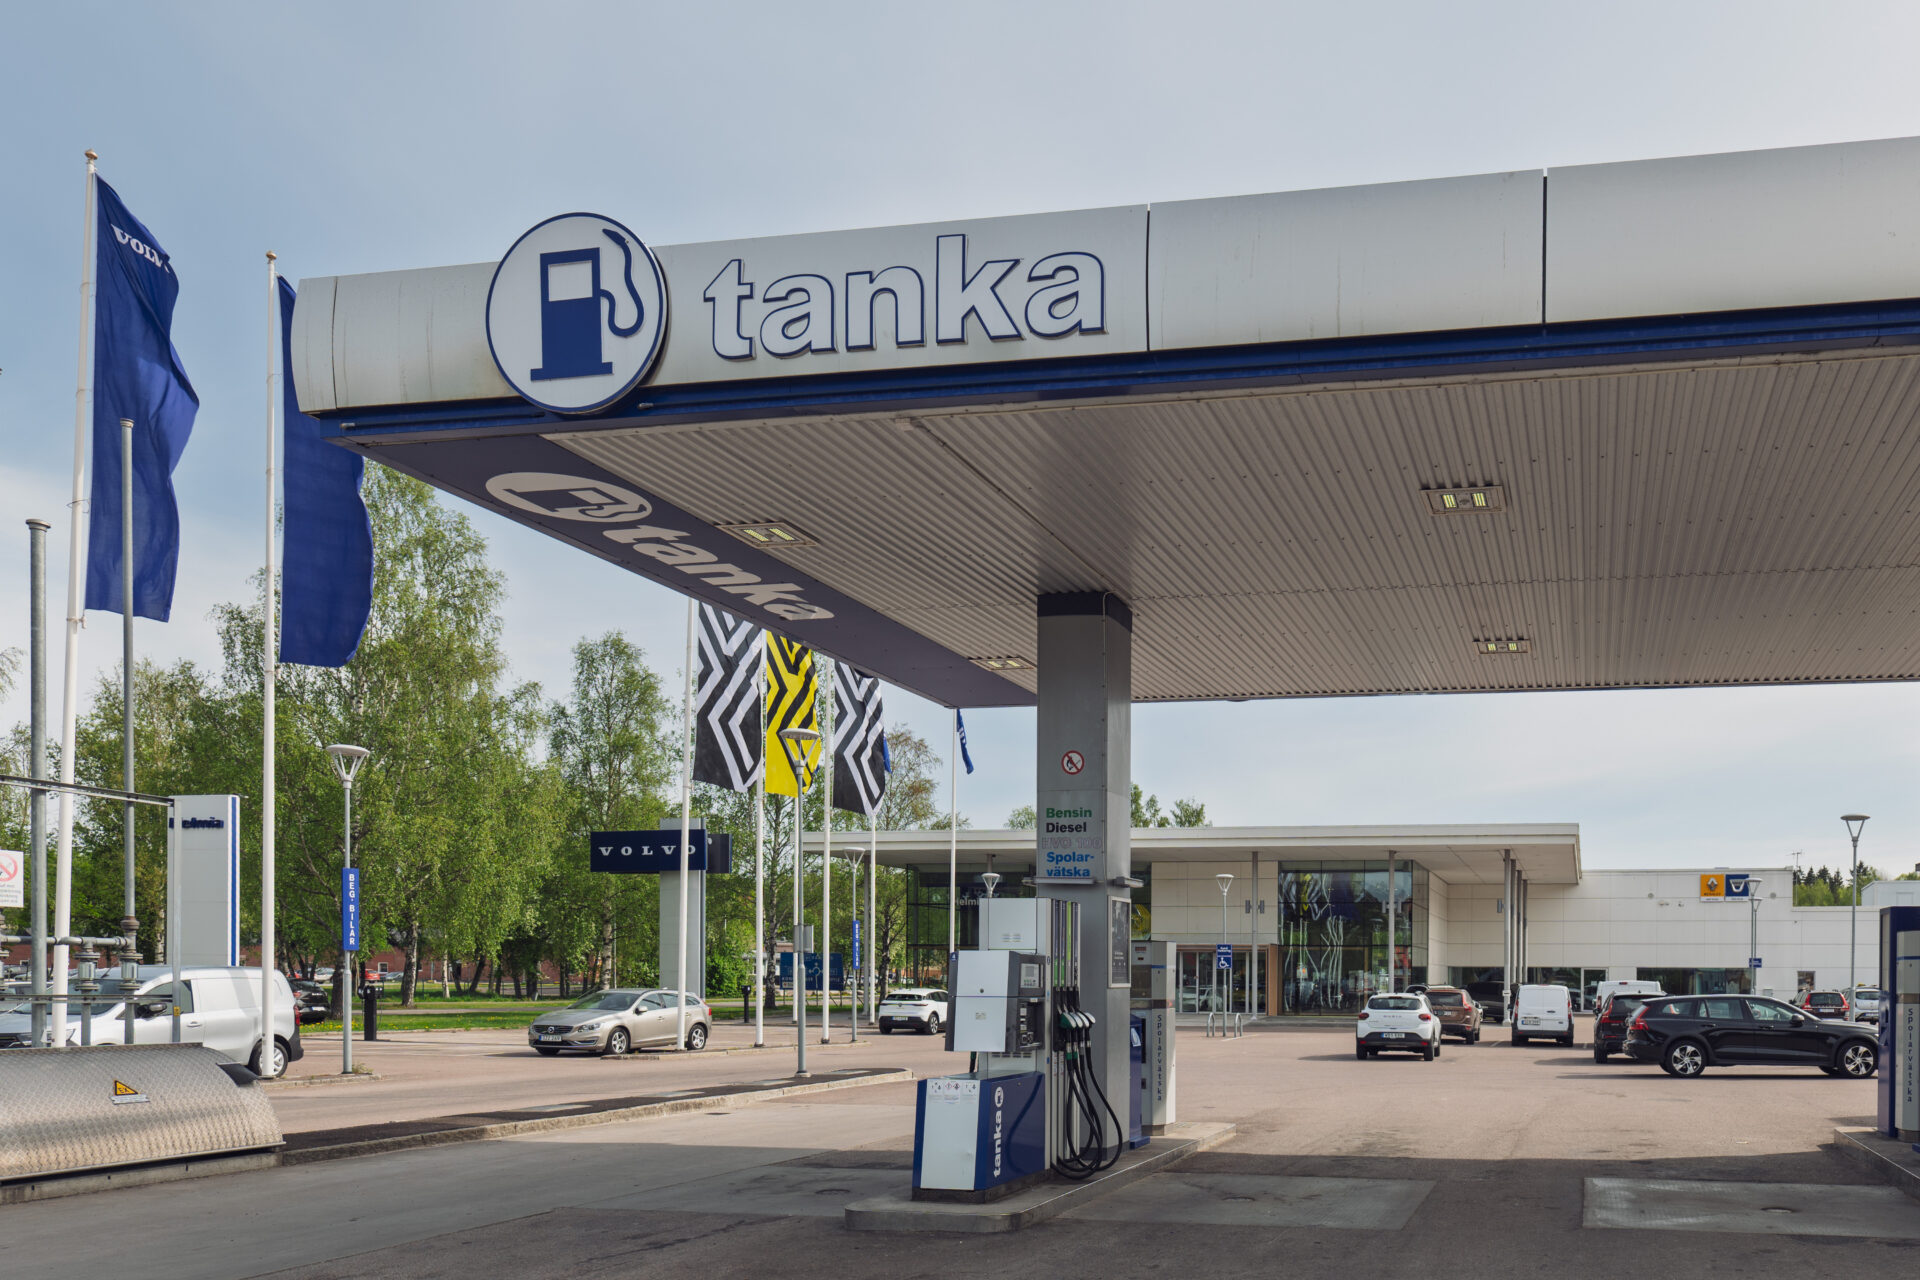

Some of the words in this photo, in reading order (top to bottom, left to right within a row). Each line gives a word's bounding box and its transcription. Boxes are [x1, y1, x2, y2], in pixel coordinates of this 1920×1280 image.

[111, 224, 170, 273] VOLV
[704, 234, 1108, 360] tanka
[603, 525, 835, 621] tanka
[1046, 807, 1092, 818] Bensin
[1046, 822, 1087, 833] Diesel
[1042, 837, 1072, 849] HVO
[1077, 837, 1102, 849] 100
[598, 845, 697, 857] VOLVO
[1046, 852, 1095, 865] Spolar-
[1046, 866, 1091, 877] vätska
[993, 1110, 1002, 1178] tanka
